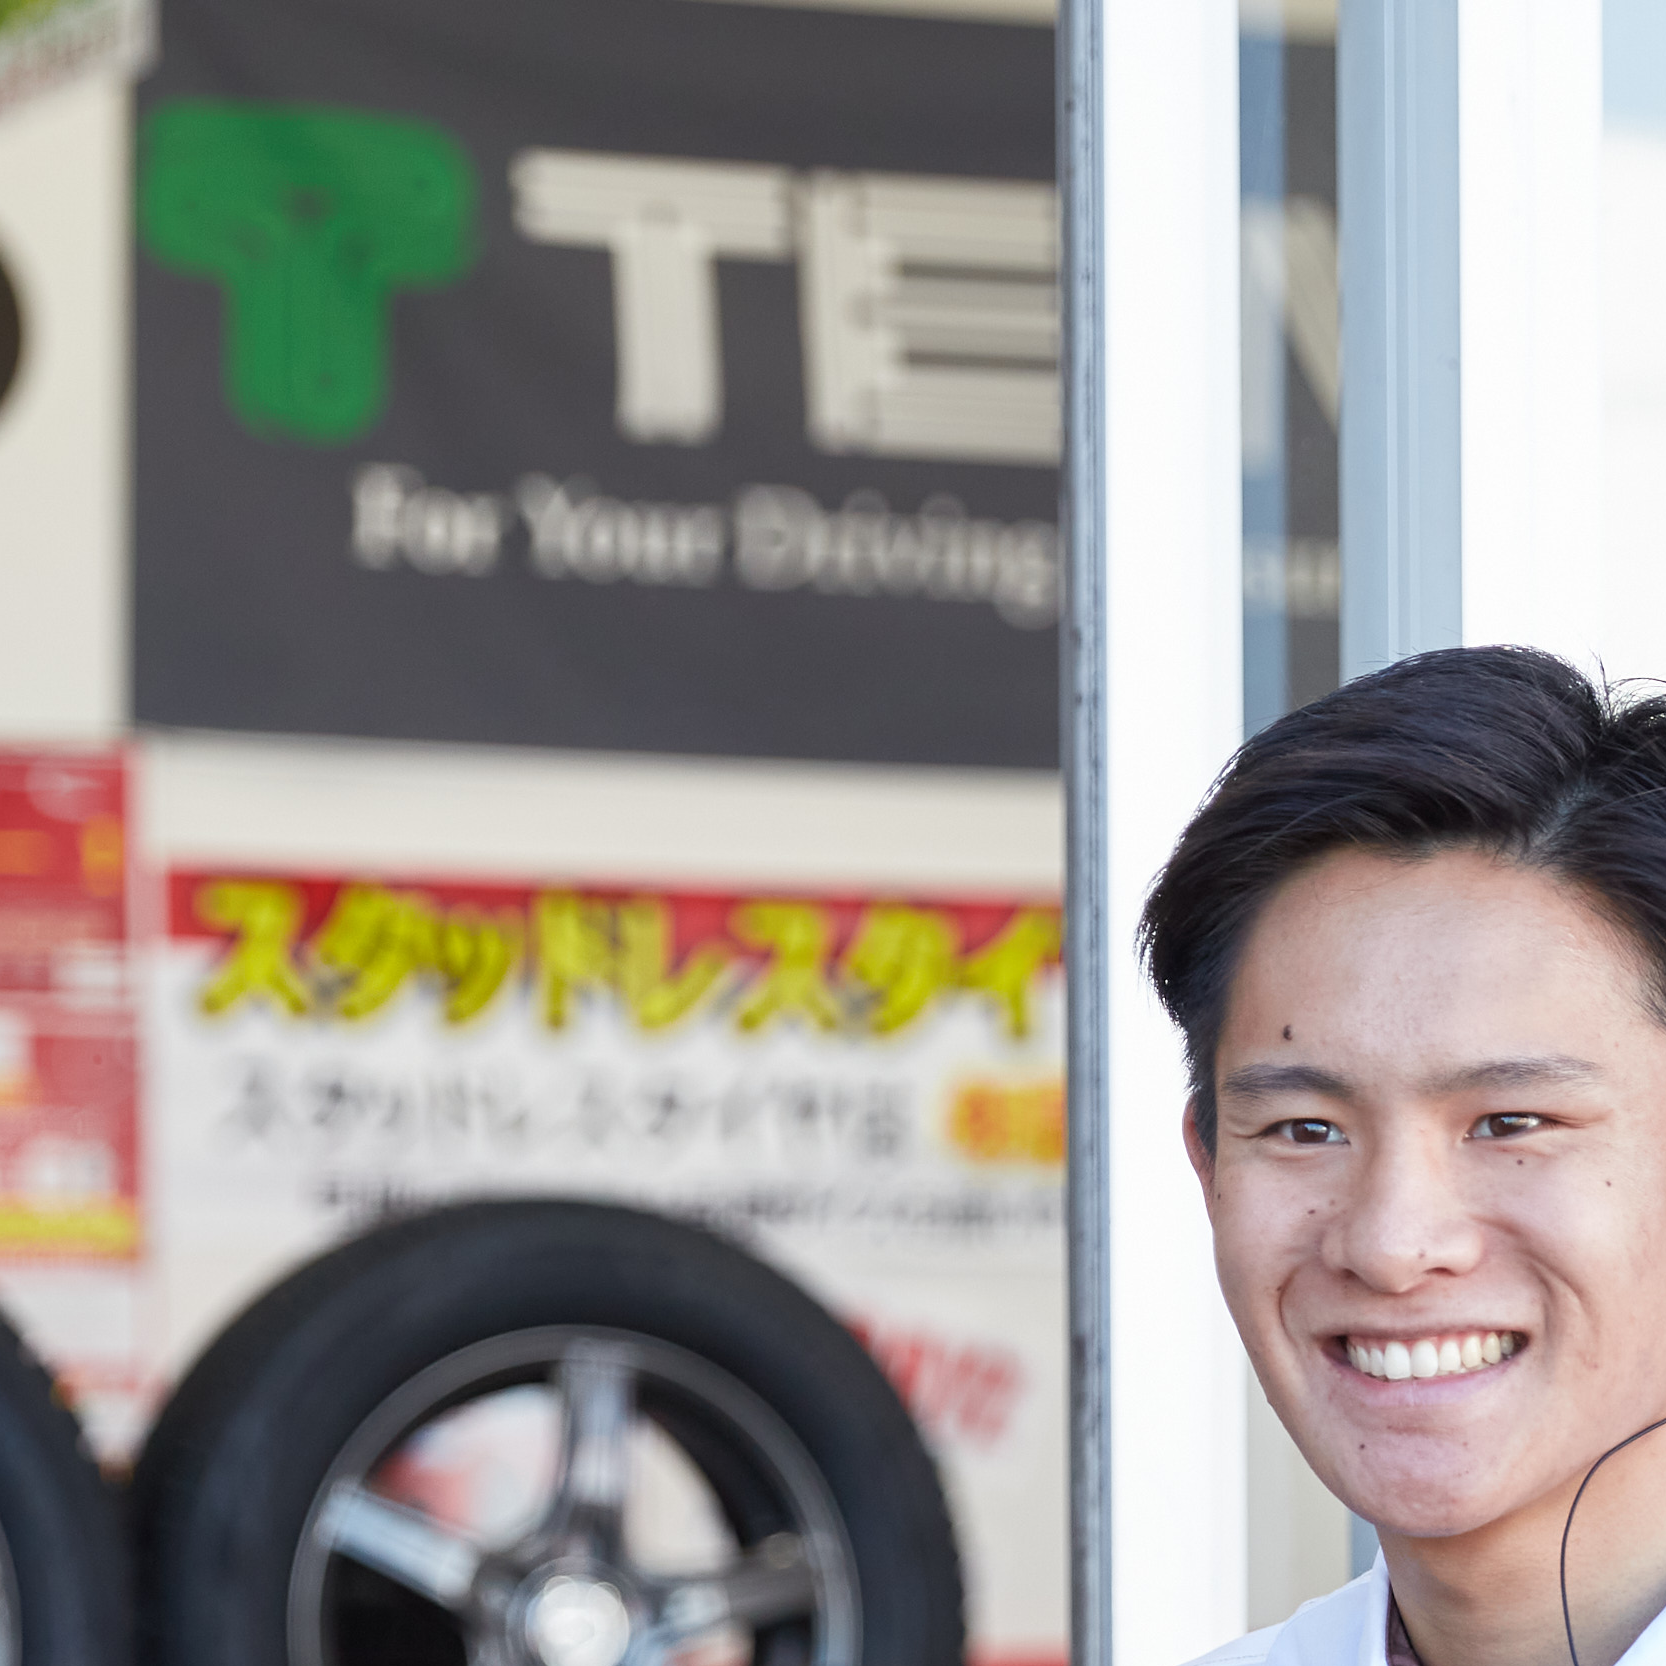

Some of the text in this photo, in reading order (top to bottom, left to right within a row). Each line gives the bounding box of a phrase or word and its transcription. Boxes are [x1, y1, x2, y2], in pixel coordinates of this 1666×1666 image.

[353, 464, 1060, 629] For Your Driving
[195, 877, 1063, 1040] スタッドレスタイ
